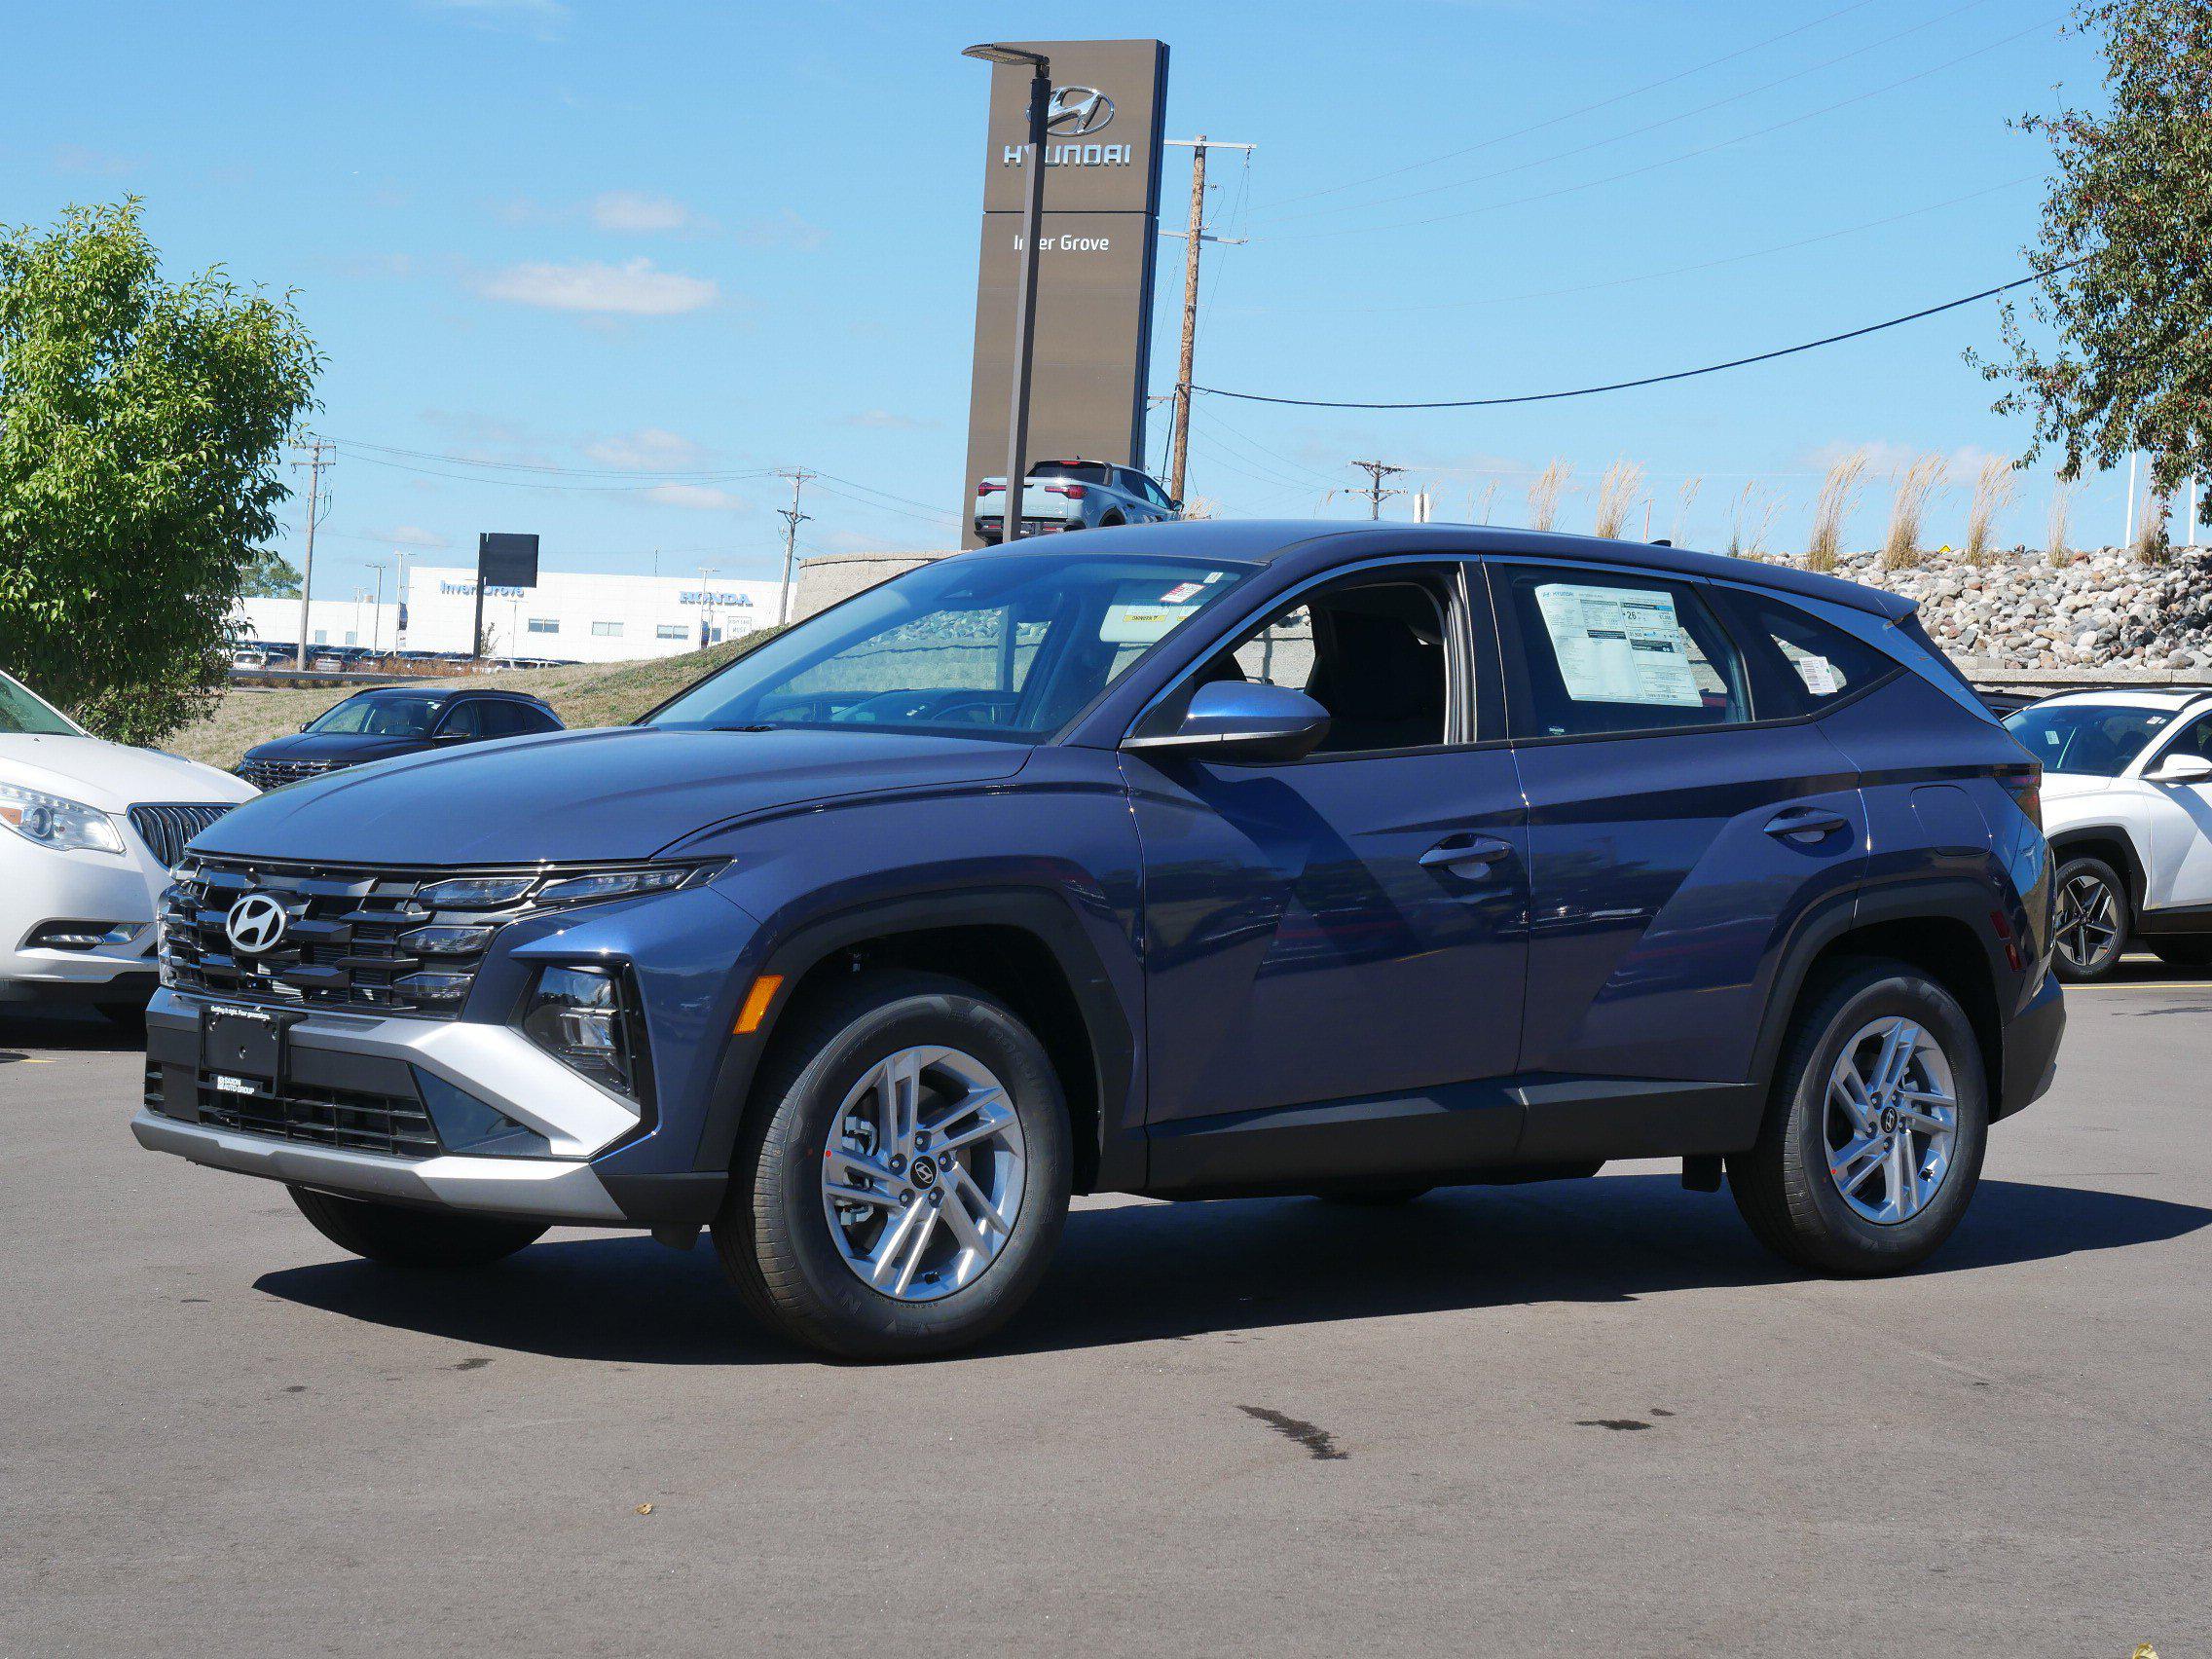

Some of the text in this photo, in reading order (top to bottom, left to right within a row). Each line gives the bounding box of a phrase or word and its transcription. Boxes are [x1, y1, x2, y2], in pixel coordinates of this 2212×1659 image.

[1014, 235, 1109, 251] Ier Grove
[679, 591, 755, 607] HONDA
[1626, 610, 1638, 620] 26
[238, 1086, 255, 1094] GROUP
